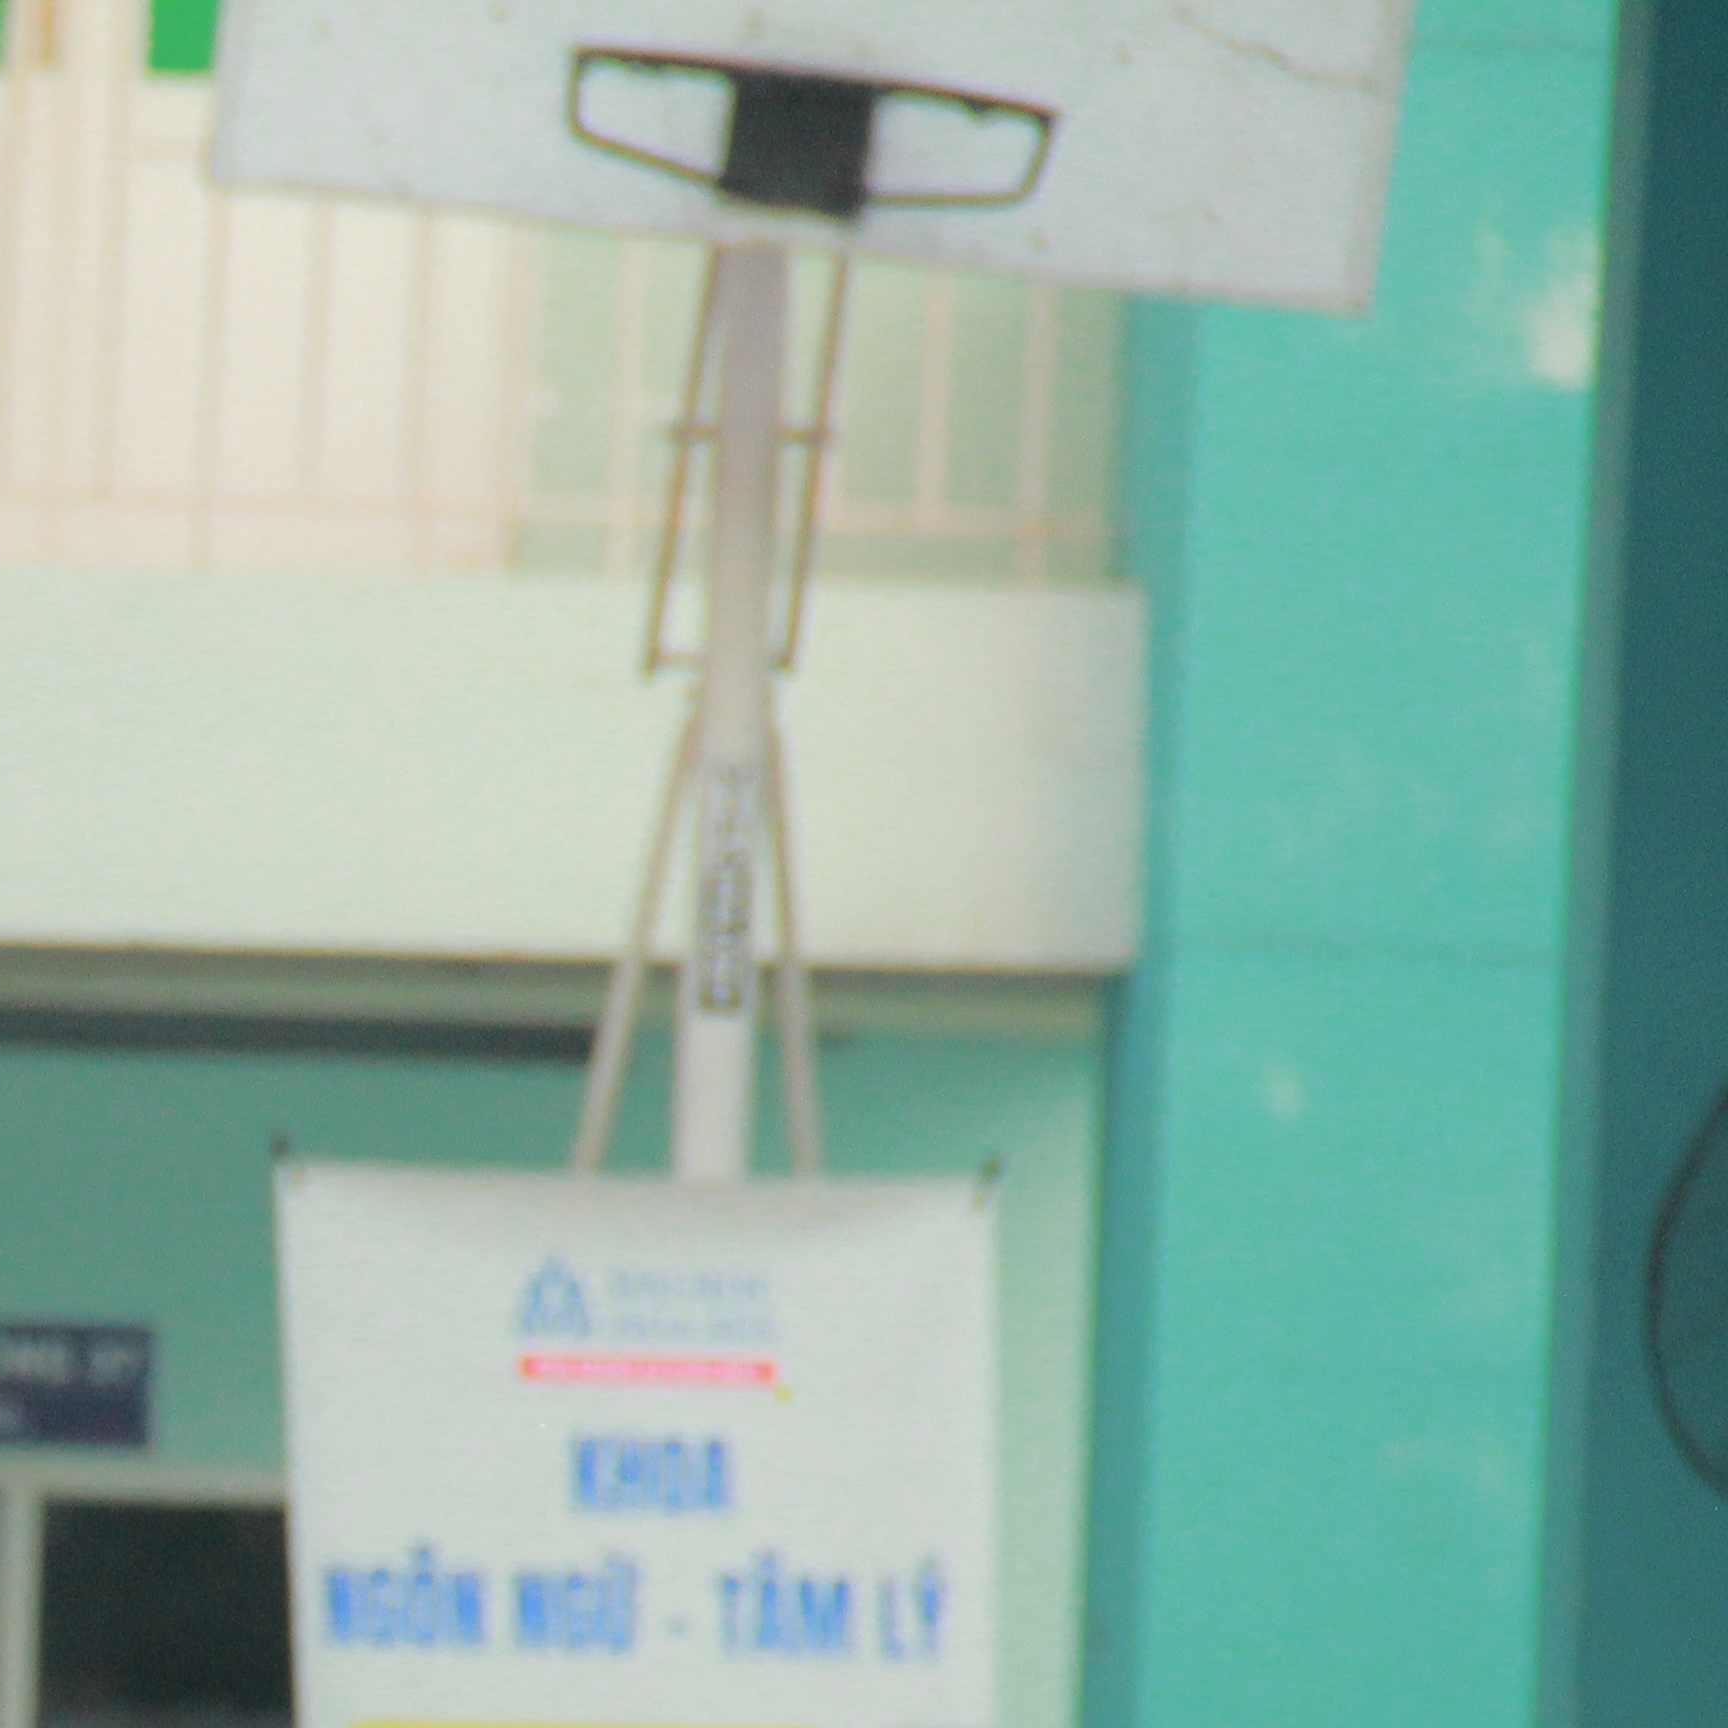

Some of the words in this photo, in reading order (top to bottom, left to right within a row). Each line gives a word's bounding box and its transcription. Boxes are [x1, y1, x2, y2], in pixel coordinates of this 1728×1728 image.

[571, 1431, 734, 1514] KHOA
[325, 1544, 482, 1646] NGÔN
[512, 1553, 639, 1653] NGỮ
[718, 1550, 850, 1656] TÂM
[877, 1555, 943, 1662] LÝ
